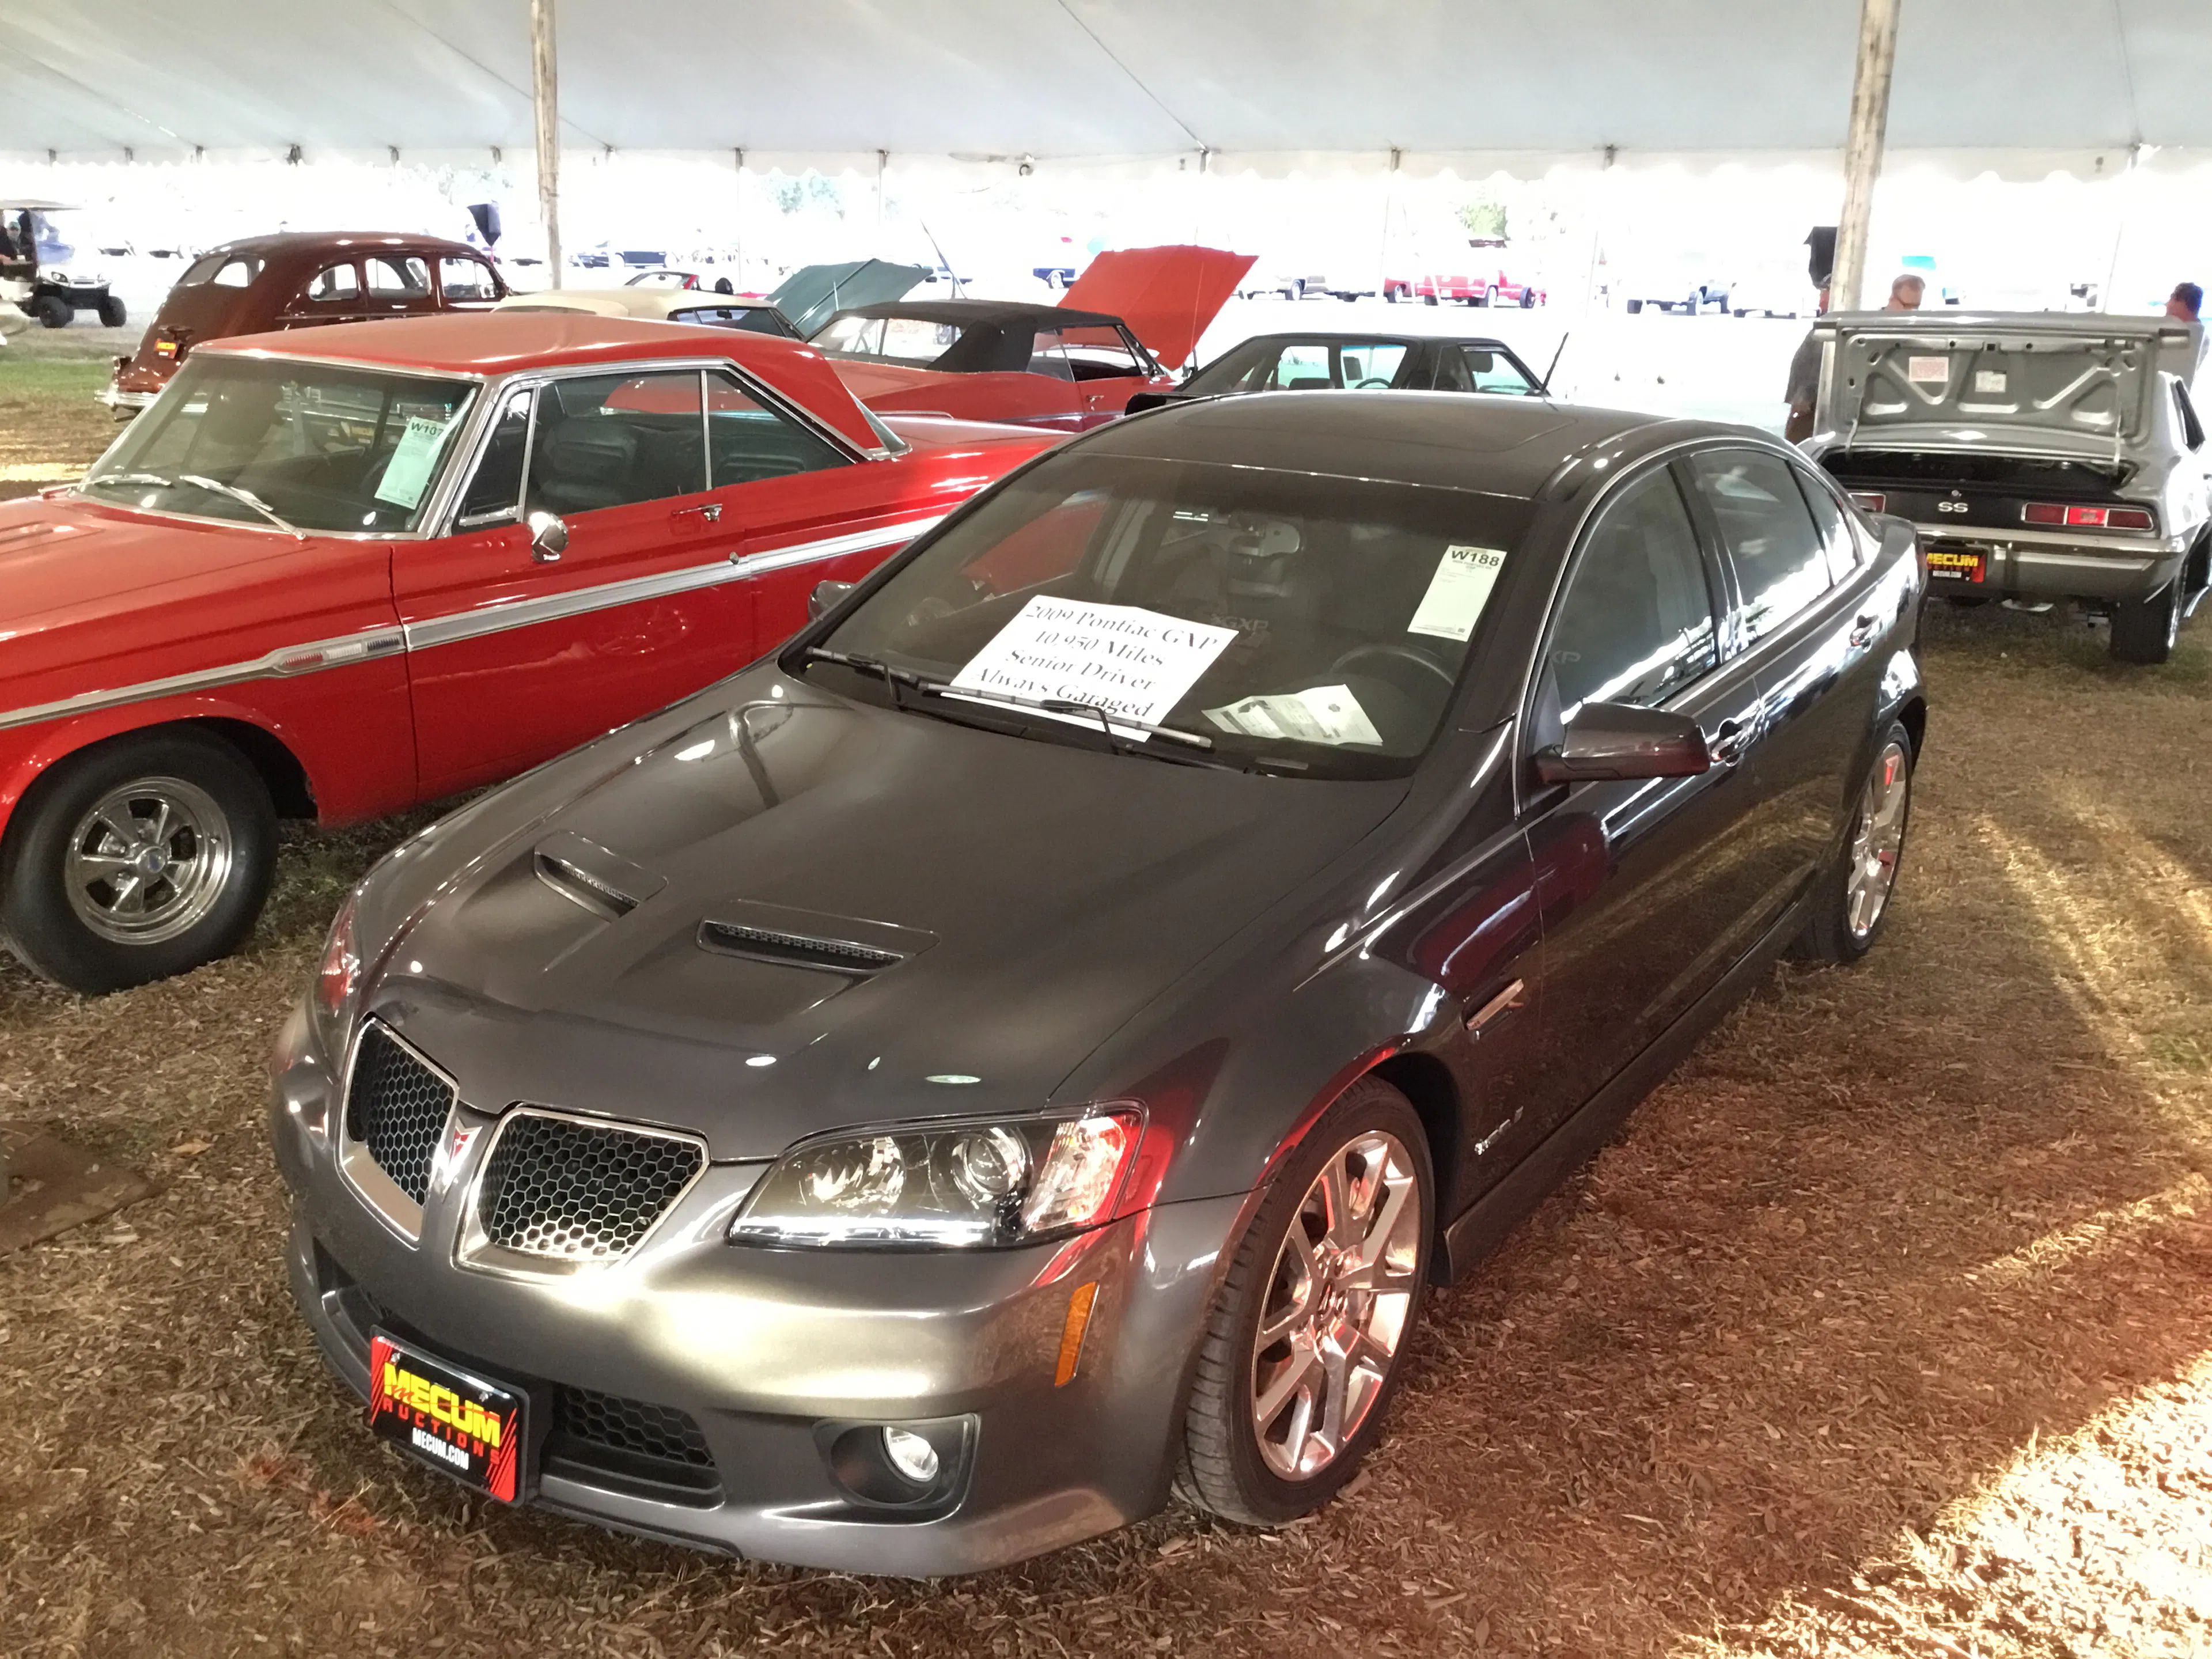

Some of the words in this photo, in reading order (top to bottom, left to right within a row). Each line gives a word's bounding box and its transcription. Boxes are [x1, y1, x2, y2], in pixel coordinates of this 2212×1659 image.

[1938, 501, 1968, 513] SS
[1452, 551, 1499, 566] W188
[1025, 606, 1074, 620] 2009
[1076, 612, 1157, 638] Pontiac
[1162, 628, 1218, 650] GXP
[1035, 631, 1100, 651] 10,950
[1101, 640, 1166, 666] Miles
[1005, 649, 1078, 673] Senior
[1081, 662, 1157, 690] Driver
[972, 668, 1050, 695] Always
[1056, 684, 1154, 717] Garaged
[384, 1362, 500, 1448] MECUM
[382, 1397, 500, 1464] AUCTIONS
[412, 1427, 469, 1470] MECUM.COM
